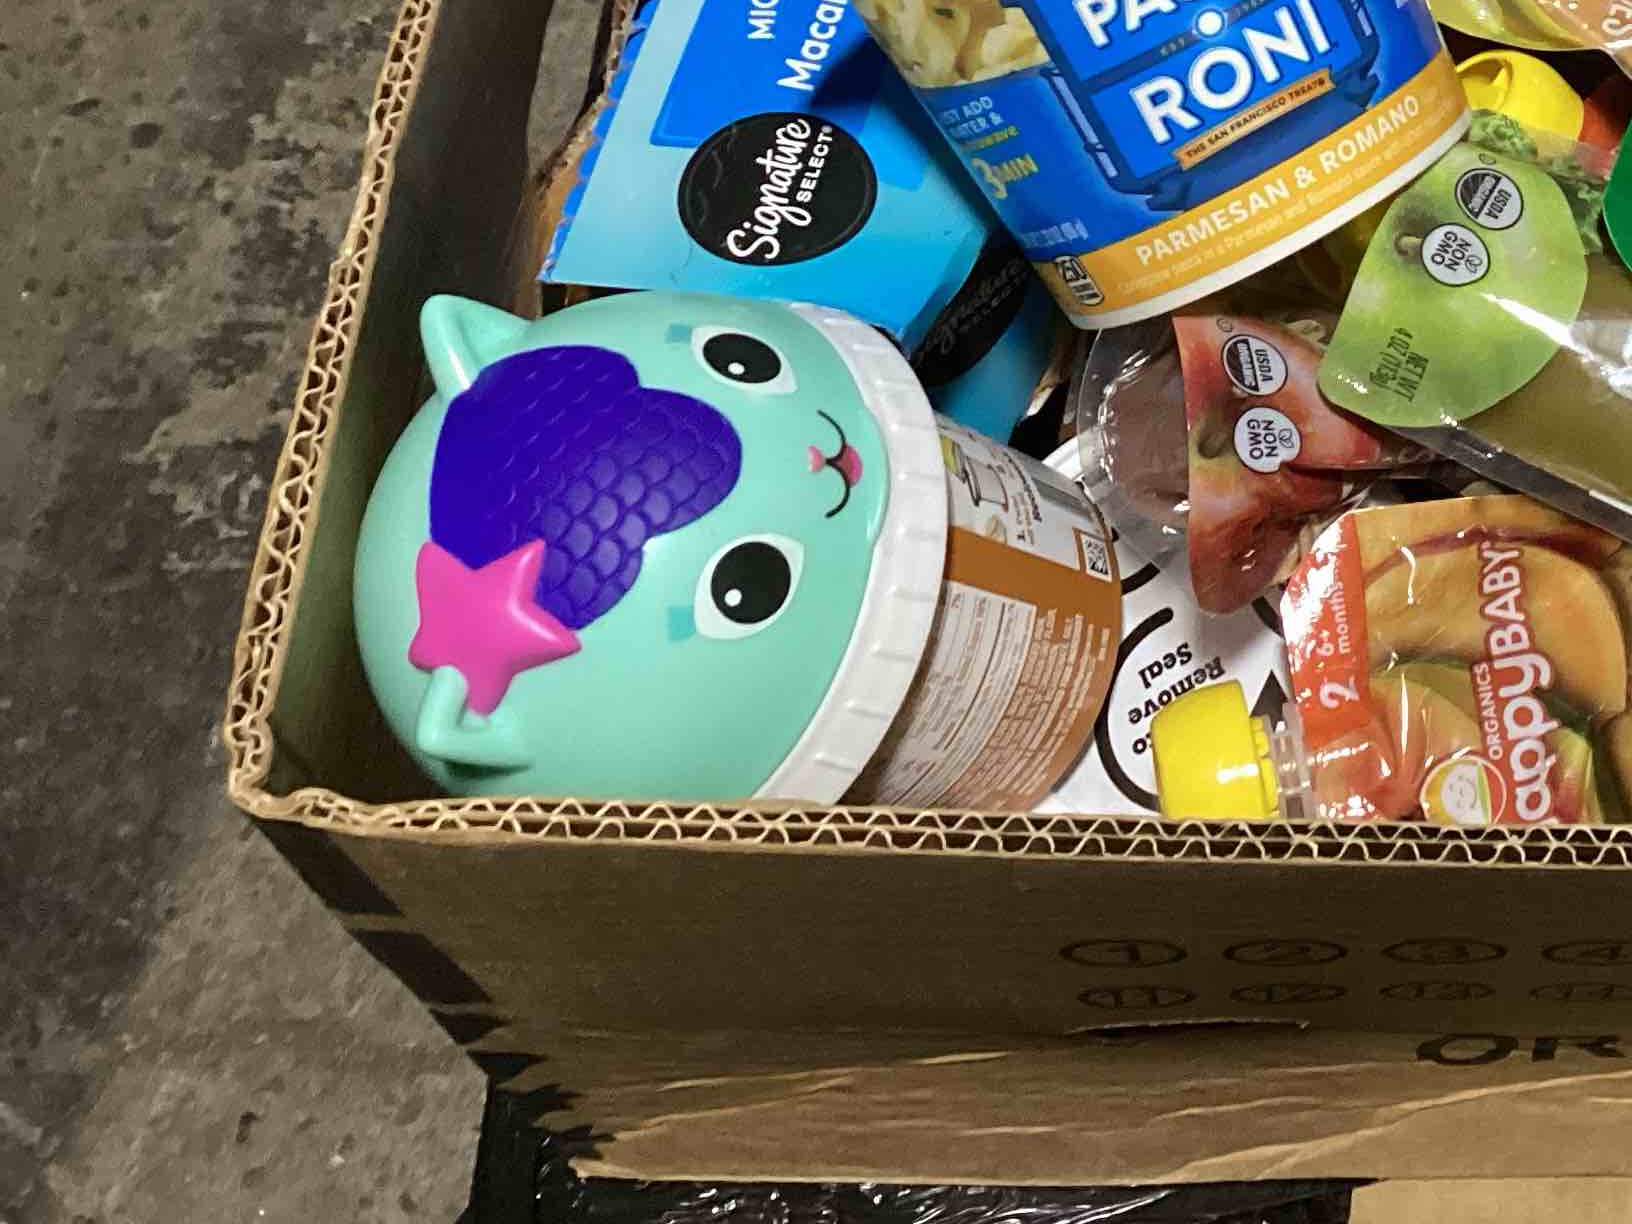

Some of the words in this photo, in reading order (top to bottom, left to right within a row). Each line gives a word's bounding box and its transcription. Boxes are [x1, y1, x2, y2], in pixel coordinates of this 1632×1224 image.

[1230, 96, 1287, 138] FRANCISCO
[798, 125, 835, 206] SELECT
[1134, 178, 1291, 266] PARMESAN
[1294, 165, 1317, 191] &
[1318, 95, 1420, 176] ROMANO
[726, 117, 812, 262] Signature
[1485, 187, 1511, 221] USDA
[1430, 231, 1459, 267] GMO
[1442, 236, 1473, 273] NON
[1253, 349, 1274, 383] USDA
[1247, 418, 1263, 460] GMO
[1261, 418, 1278, 458] NON
[1137, 641, 1194, 690] Seal
[1482, 542, 1560, 823] appyBABY
[1127, 656, 1227, 725] Remove
[1472, 662, 1504, 761] ORGANICS
